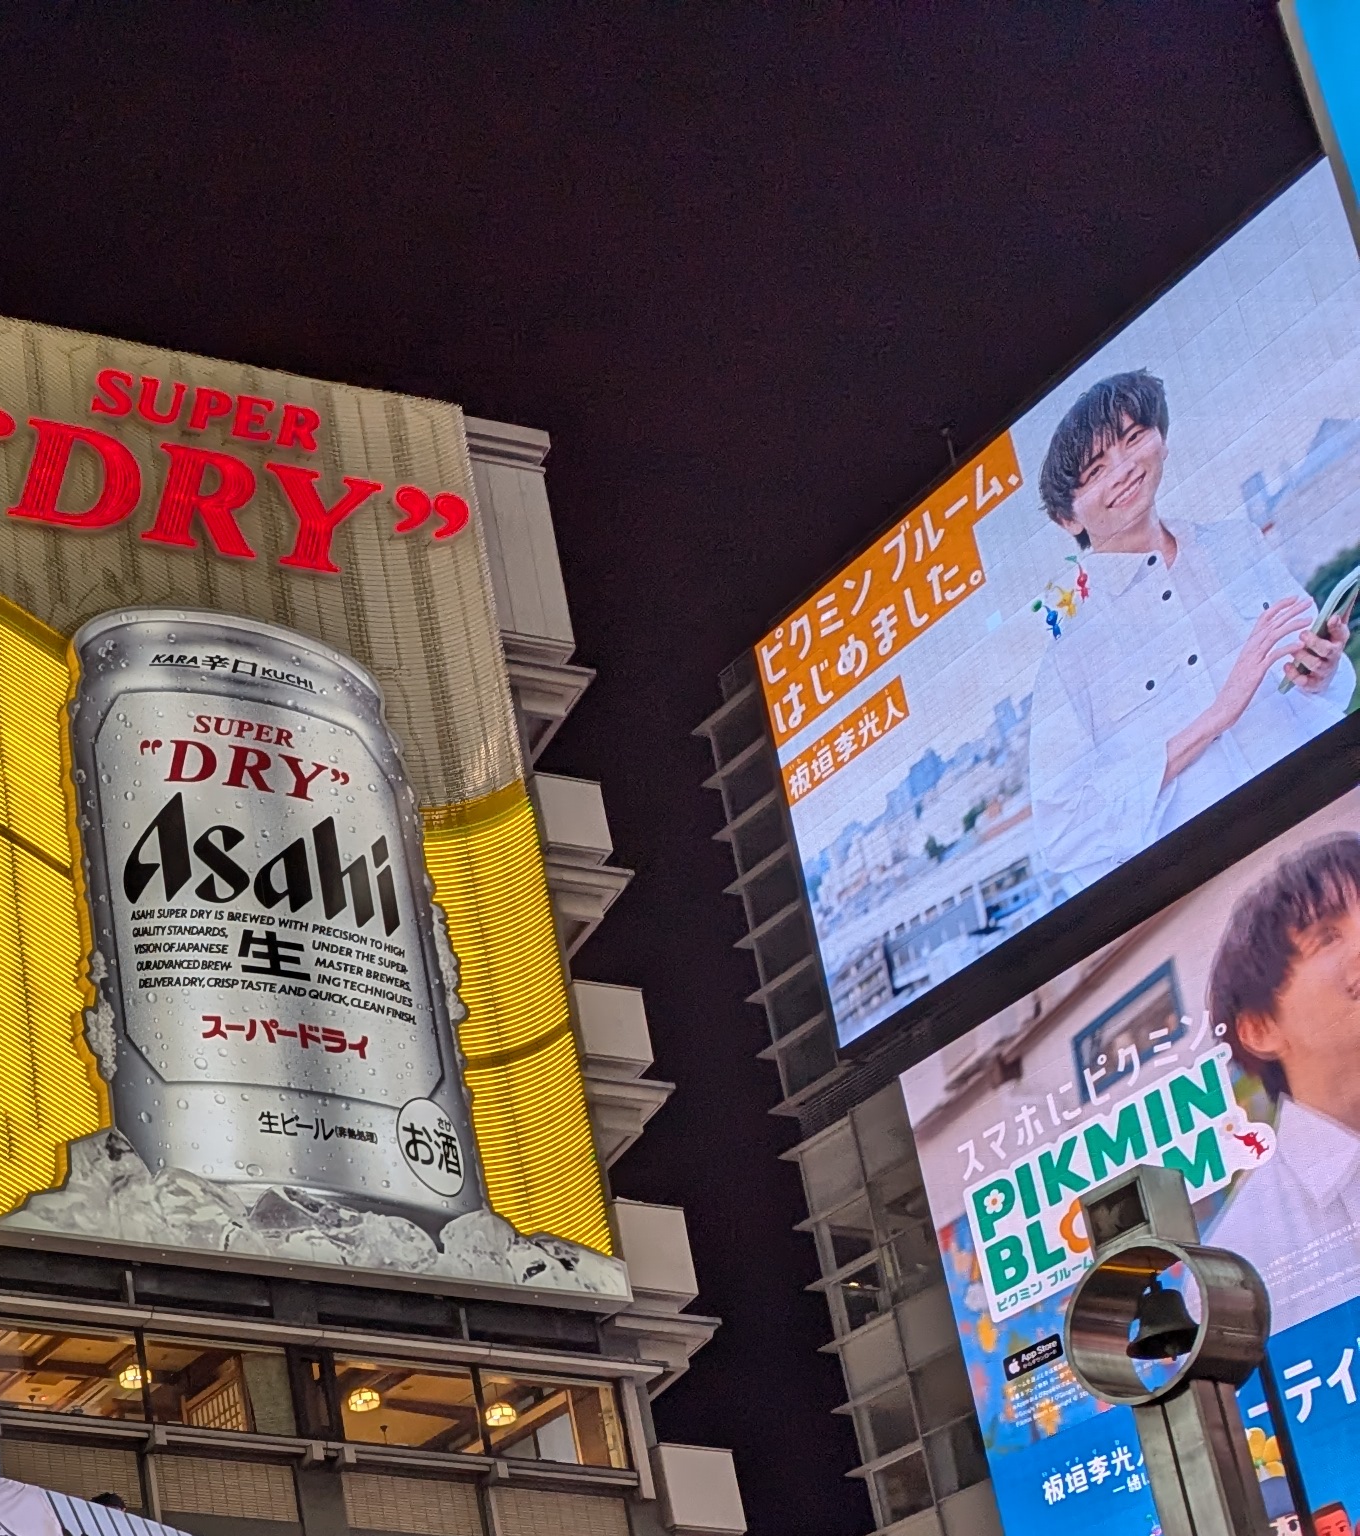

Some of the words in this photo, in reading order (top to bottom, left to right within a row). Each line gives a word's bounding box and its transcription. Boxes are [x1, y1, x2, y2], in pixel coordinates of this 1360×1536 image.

[91, 367, 321, 453] SUPER
[760, 570, 879, 686] ピクミン
[772, 568, 984, 735] はじめました。
[150, 653, 199, 668] KARA
[202, 654, 258, 678] 辛口
[259, 665, 316, 692] KUCHI
[193, 714, 295, 749] SUPER
[788, 695, 905, 800] 板垣李光人
[124, 791, 401, 937] Asahi
[130, 909, 155, 921] ASAHI
[157, 908, 188, 919] SUPER
[190, 909, 213, 920] DRY
[214, 910, 225, 921] IS
[227, 911, 276, 926] BREWED
[278, 917, 309, 933] WITH
[311, 923, 368, 946] PRECISION
[369, 938, 383, 950] TO
[383, 943, 406, 958] HIGH
[132, 926, 167, 938] QUALITY
[167, 925, 229, 938] STANDARDS,
[311, 939, 353, 958] UNDER
[354, 949, 376, 964] THE
[238, 928, 311, 982] 生
[136, 960, 153, 972] OUR
[316, 973, 341, 988] ING
[342, 977, 413, 1008] TECHNIQUES
[163, 942, 175, 953] OF
[175, 943, 229, 954] JAPANESE
[314, 956, 364, 977] MASTER
[182, 976, 207, 989] DRY,
[206, 977, 240, 989] CRISP
[240, 979, 278, 994] TASTE
[277, 984, 307, 997] AND
[308, 988, 350, 1007] QUICK,
[350, 997, 385, 1016] CLEAN
[200, 1014, 370, 1060] スーパードライ
[957, 1010, 1227, 1181] スマホにピクミン。
[402, 1122, 463, 1179] お酒
[971, 1058, 1228, 1243] PIKMIN
[995, 1282, 1044, 1313] ピクミン
[1021, 1345, 1037, 1363] App
[1036, 1339, 1058, 1356] Store
